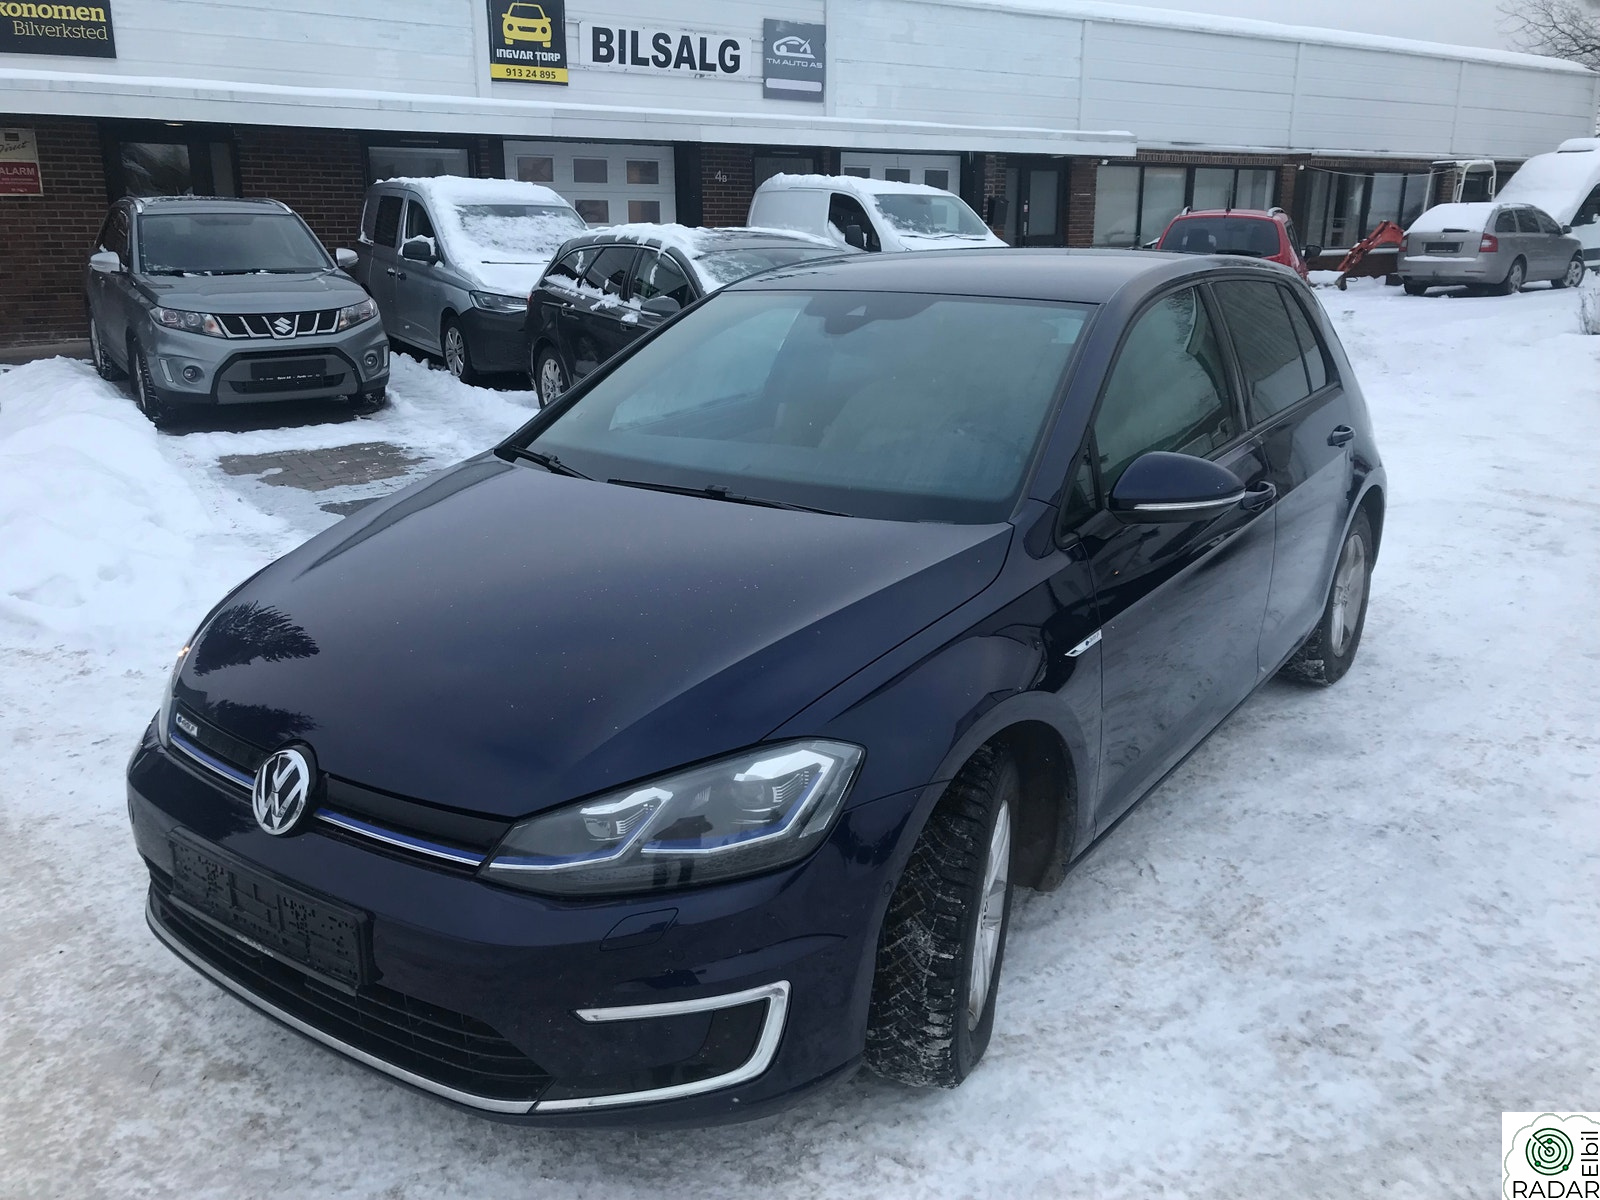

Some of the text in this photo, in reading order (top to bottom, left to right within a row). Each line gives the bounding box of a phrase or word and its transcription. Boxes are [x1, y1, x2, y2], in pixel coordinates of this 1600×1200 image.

[13, 20, 108, 40] Bilverksted
[496, 48, 561, 62] INGVAR TORP
[592, 26, 741, 74] BILSALG
[766, 57, 781, 65] TM
[782, 60, 808, 68] AUTO
[506, 67, 556, 79] 913 24 895
[0, 167, 35, 175] ALARM
